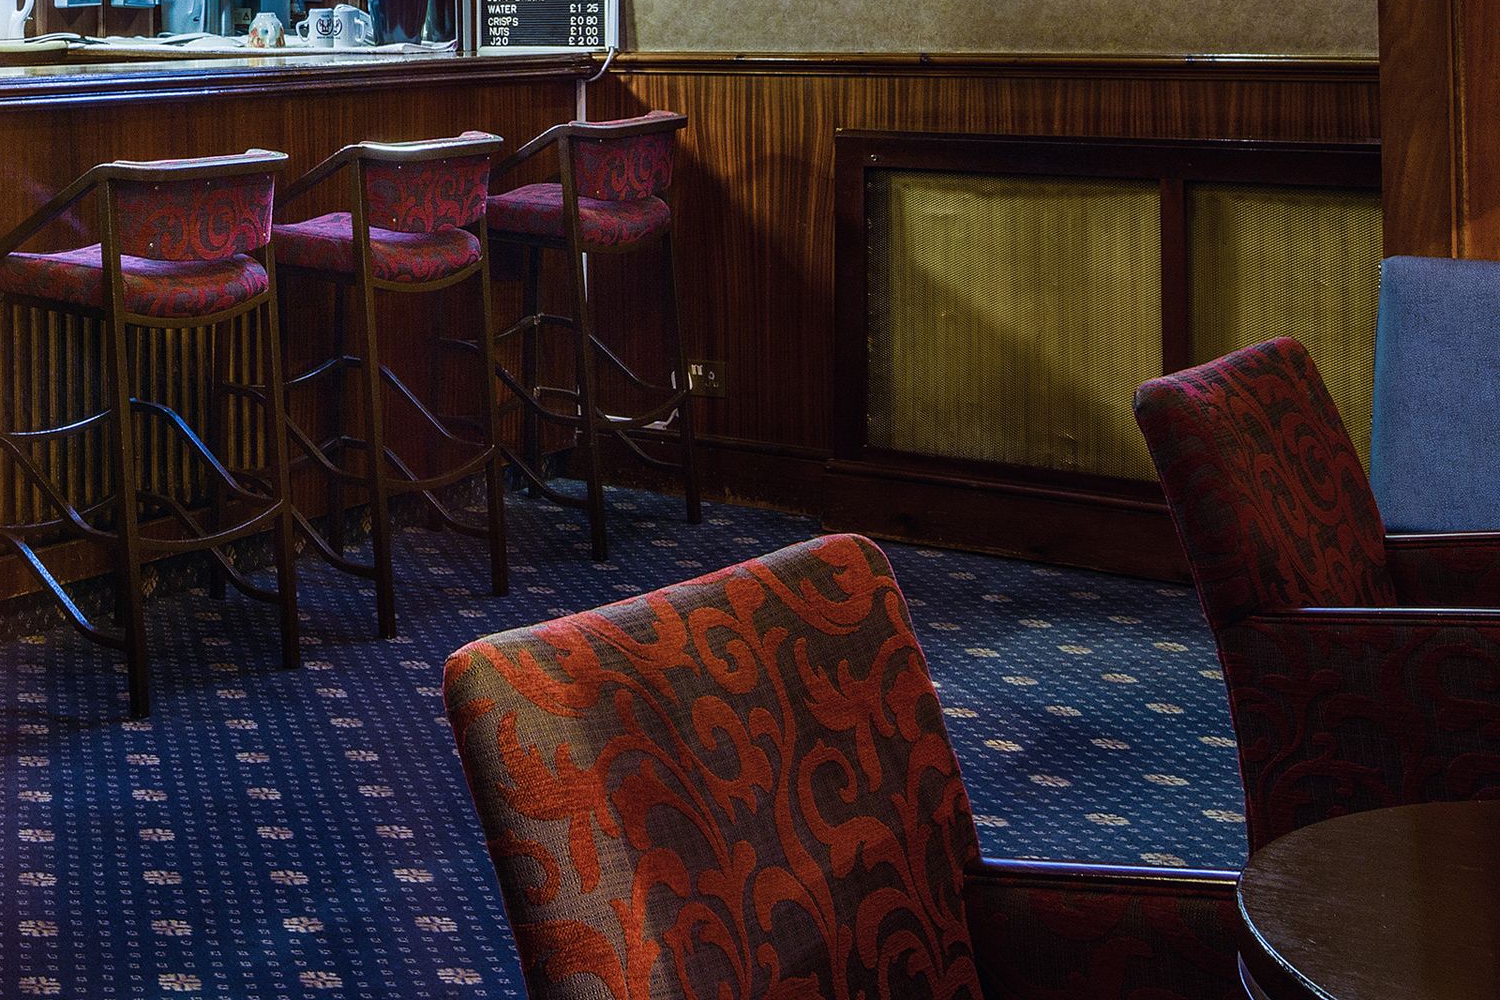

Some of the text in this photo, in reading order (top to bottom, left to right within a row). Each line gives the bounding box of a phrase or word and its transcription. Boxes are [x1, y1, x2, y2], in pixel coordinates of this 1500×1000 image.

[488, 4, 517, 14] WATER
[488, 17, 519, 27] CRISPS
[489, 27, 510, 36] NUTS
